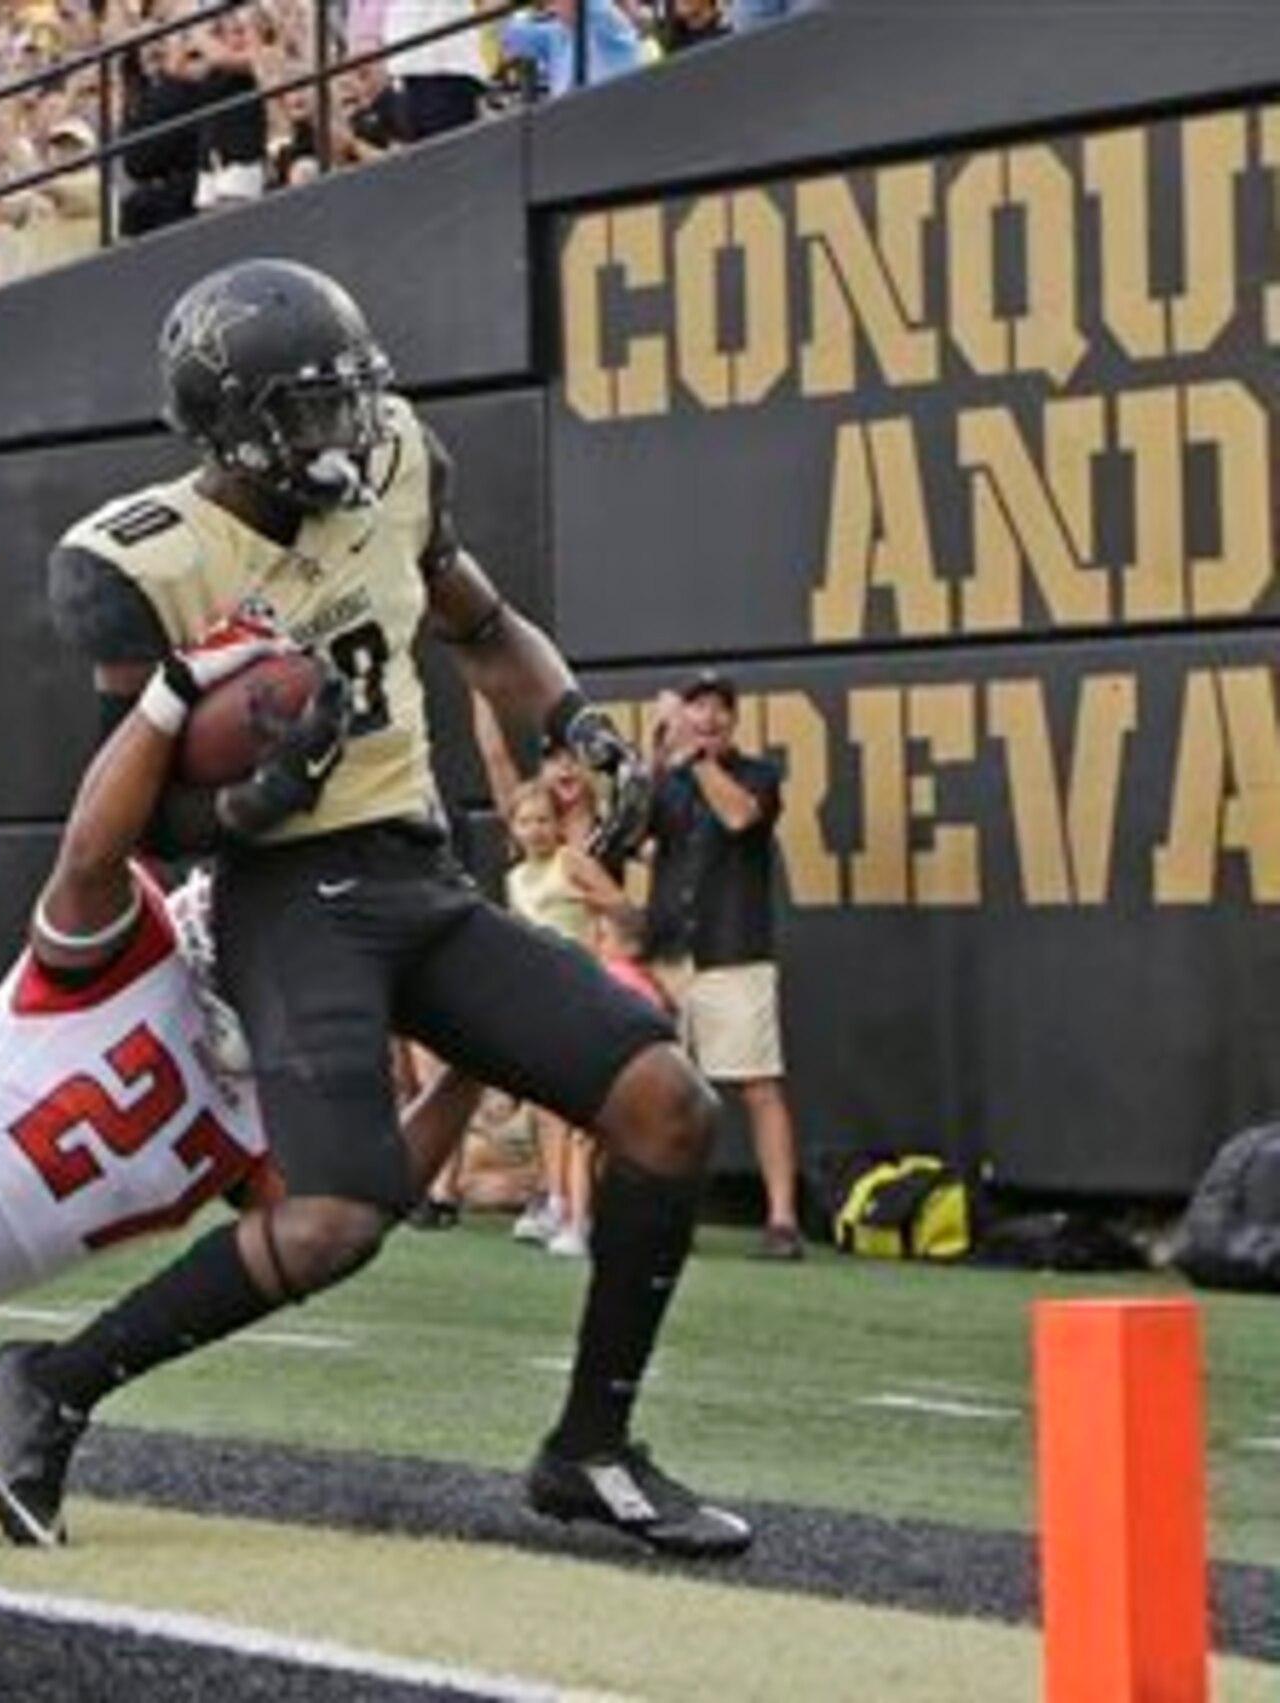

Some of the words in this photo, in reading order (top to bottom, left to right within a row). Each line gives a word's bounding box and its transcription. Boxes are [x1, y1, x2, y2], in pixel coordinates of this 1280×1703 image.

[560, 105, 1280, 422] CONQU
[811, 378, 1272, 643] AND
[7, 1020, 264, 1253] 27
